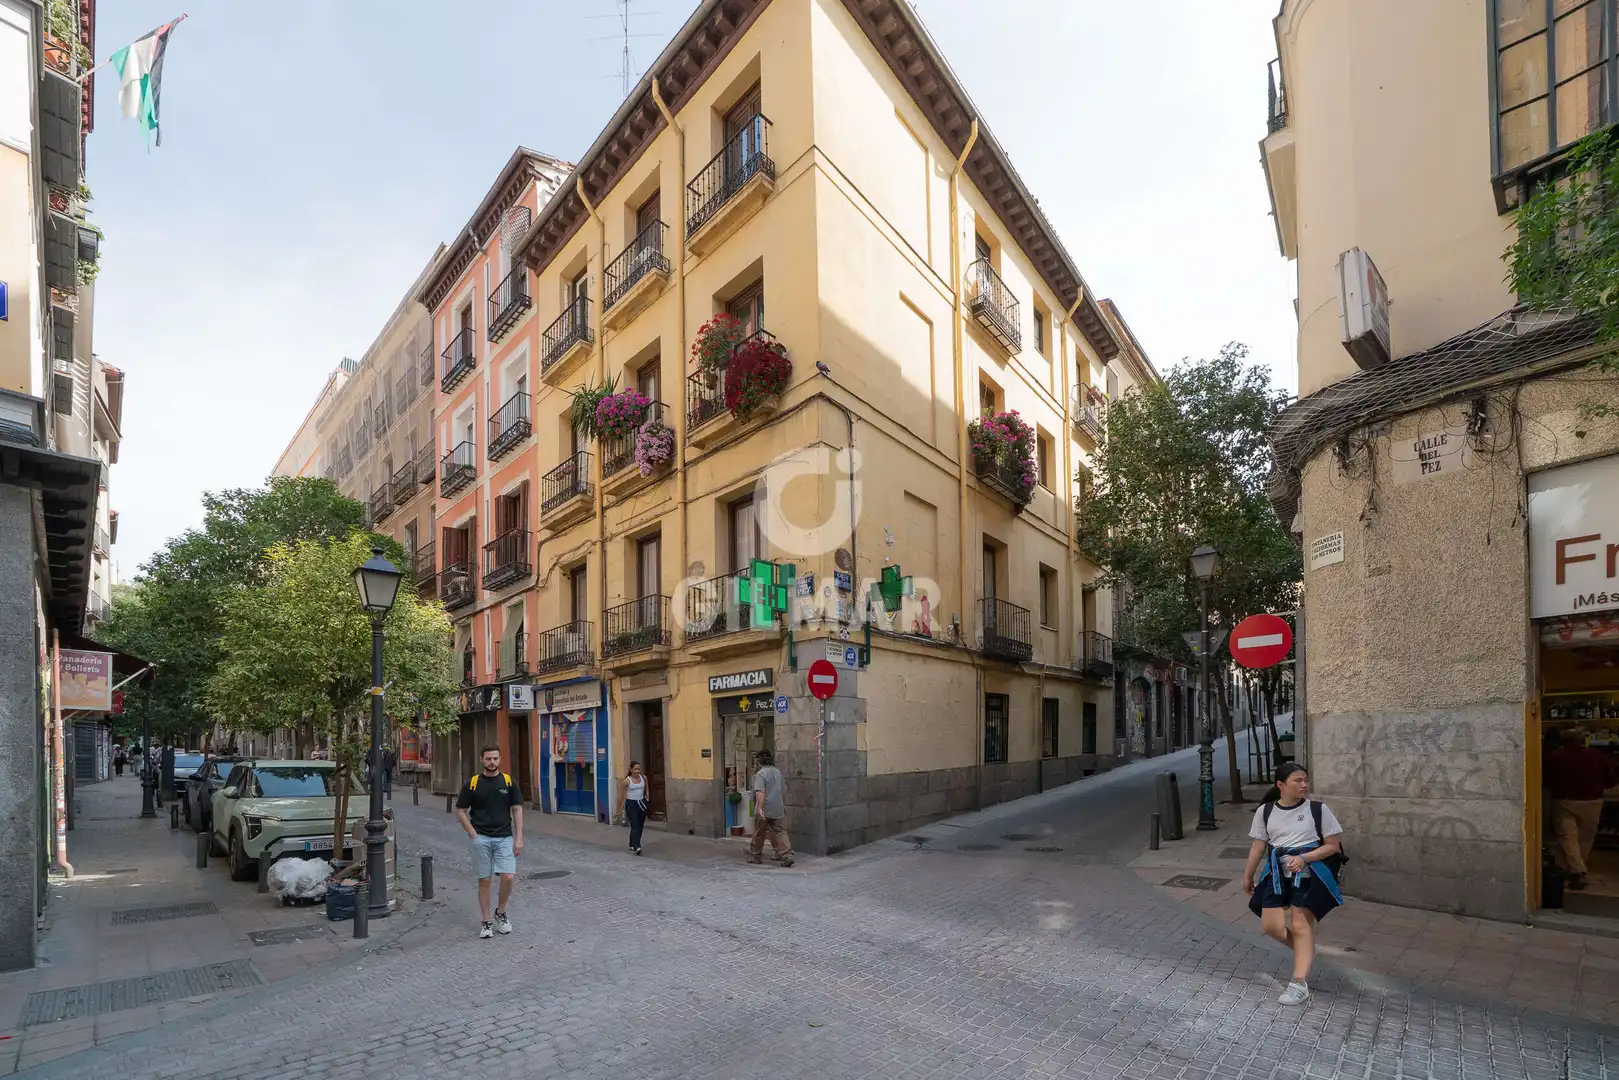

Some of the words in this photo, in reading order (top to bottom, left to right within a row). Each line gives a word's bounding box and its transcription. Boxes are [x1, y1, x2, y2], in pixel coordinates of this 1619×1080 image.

[1413, 434, 1448, 452] CALLE
[1419, 450, 1441, 461] DEL
[1421, 460, 1441, 475] PEZ
[709, 671, 767, 691] FARMACIA
